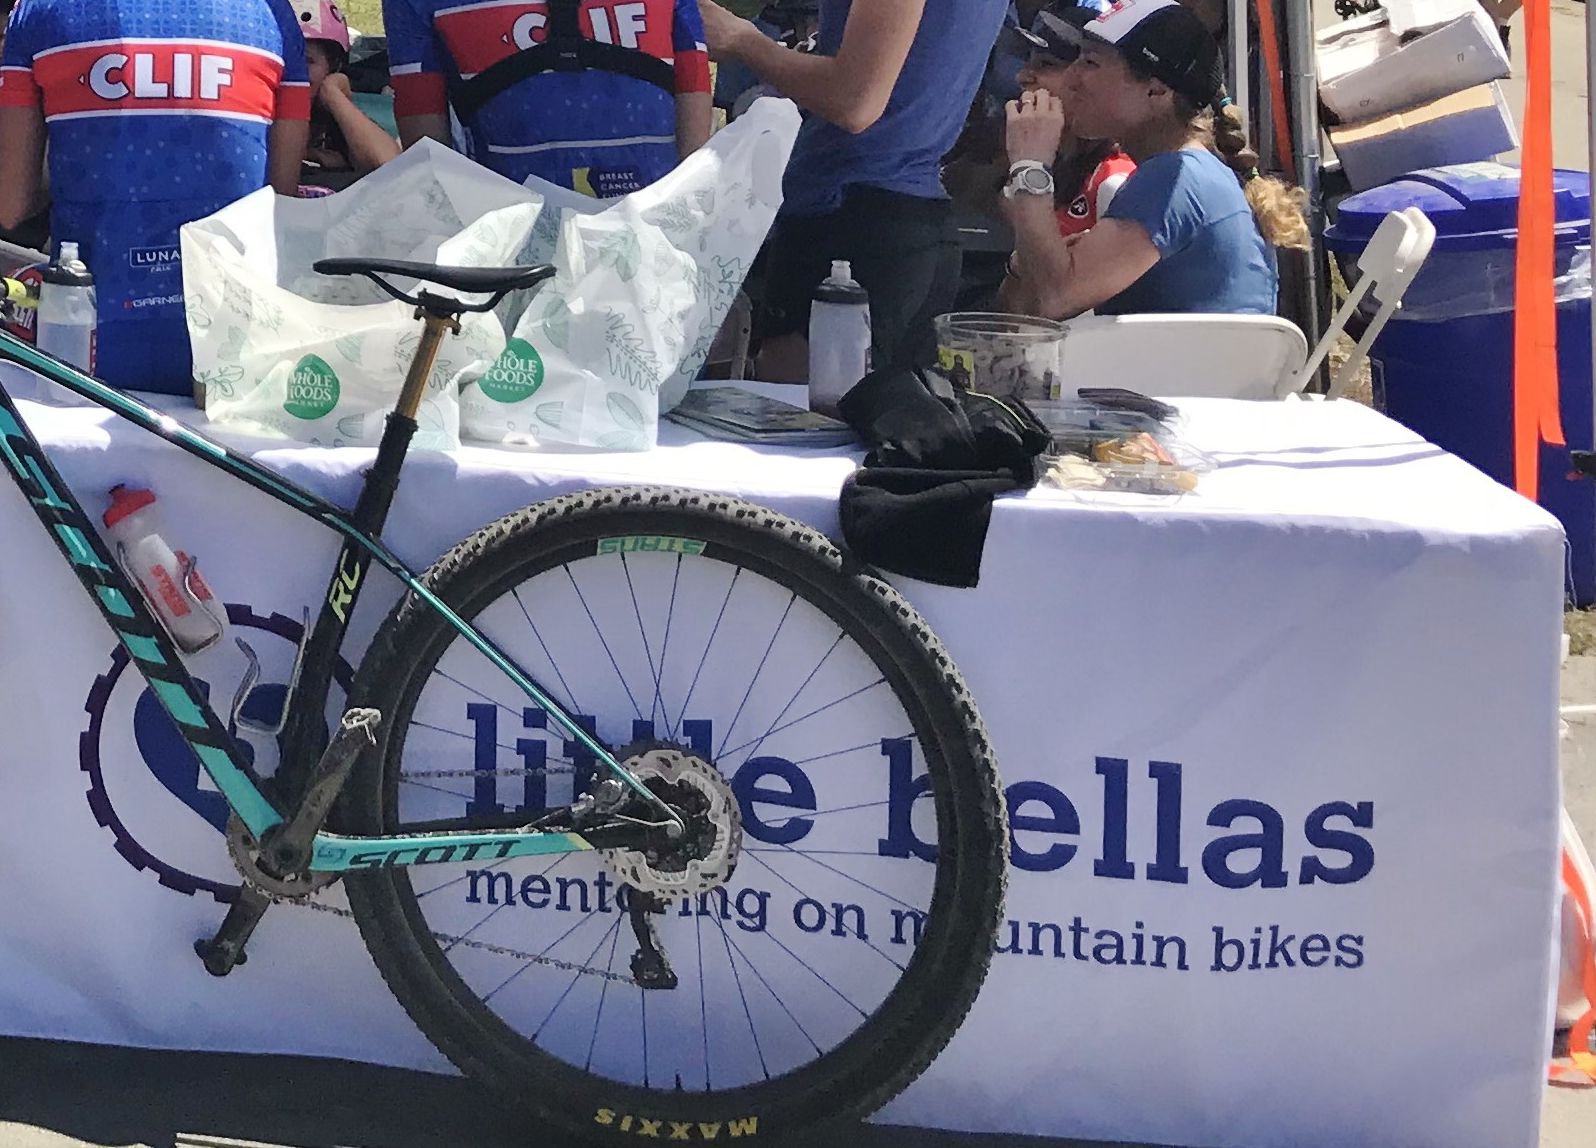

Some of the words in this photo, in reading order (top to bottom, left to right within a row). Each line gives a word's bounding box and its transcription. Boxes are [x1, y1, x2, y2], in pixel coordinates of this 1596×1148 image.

[513, 2, 648, 50] CIF
[88, 53, 233, 101] CLIF
[599, 172, 634, 180] BREAST
[601, 182, 641, 191] CANCER
[136, 250, 181, 264] LUNA
[485, 365, 536, 386] FOODS
[329, 546, 362, 624] RC
[348, 839, 522, 869] SCOTT
[792, 893, 867, 937] on
[891, 905, 1189, 971] muntain
[1210, 923, 1366, 972] bikes
[595, 1105, 759, 1141] MAXXIS
